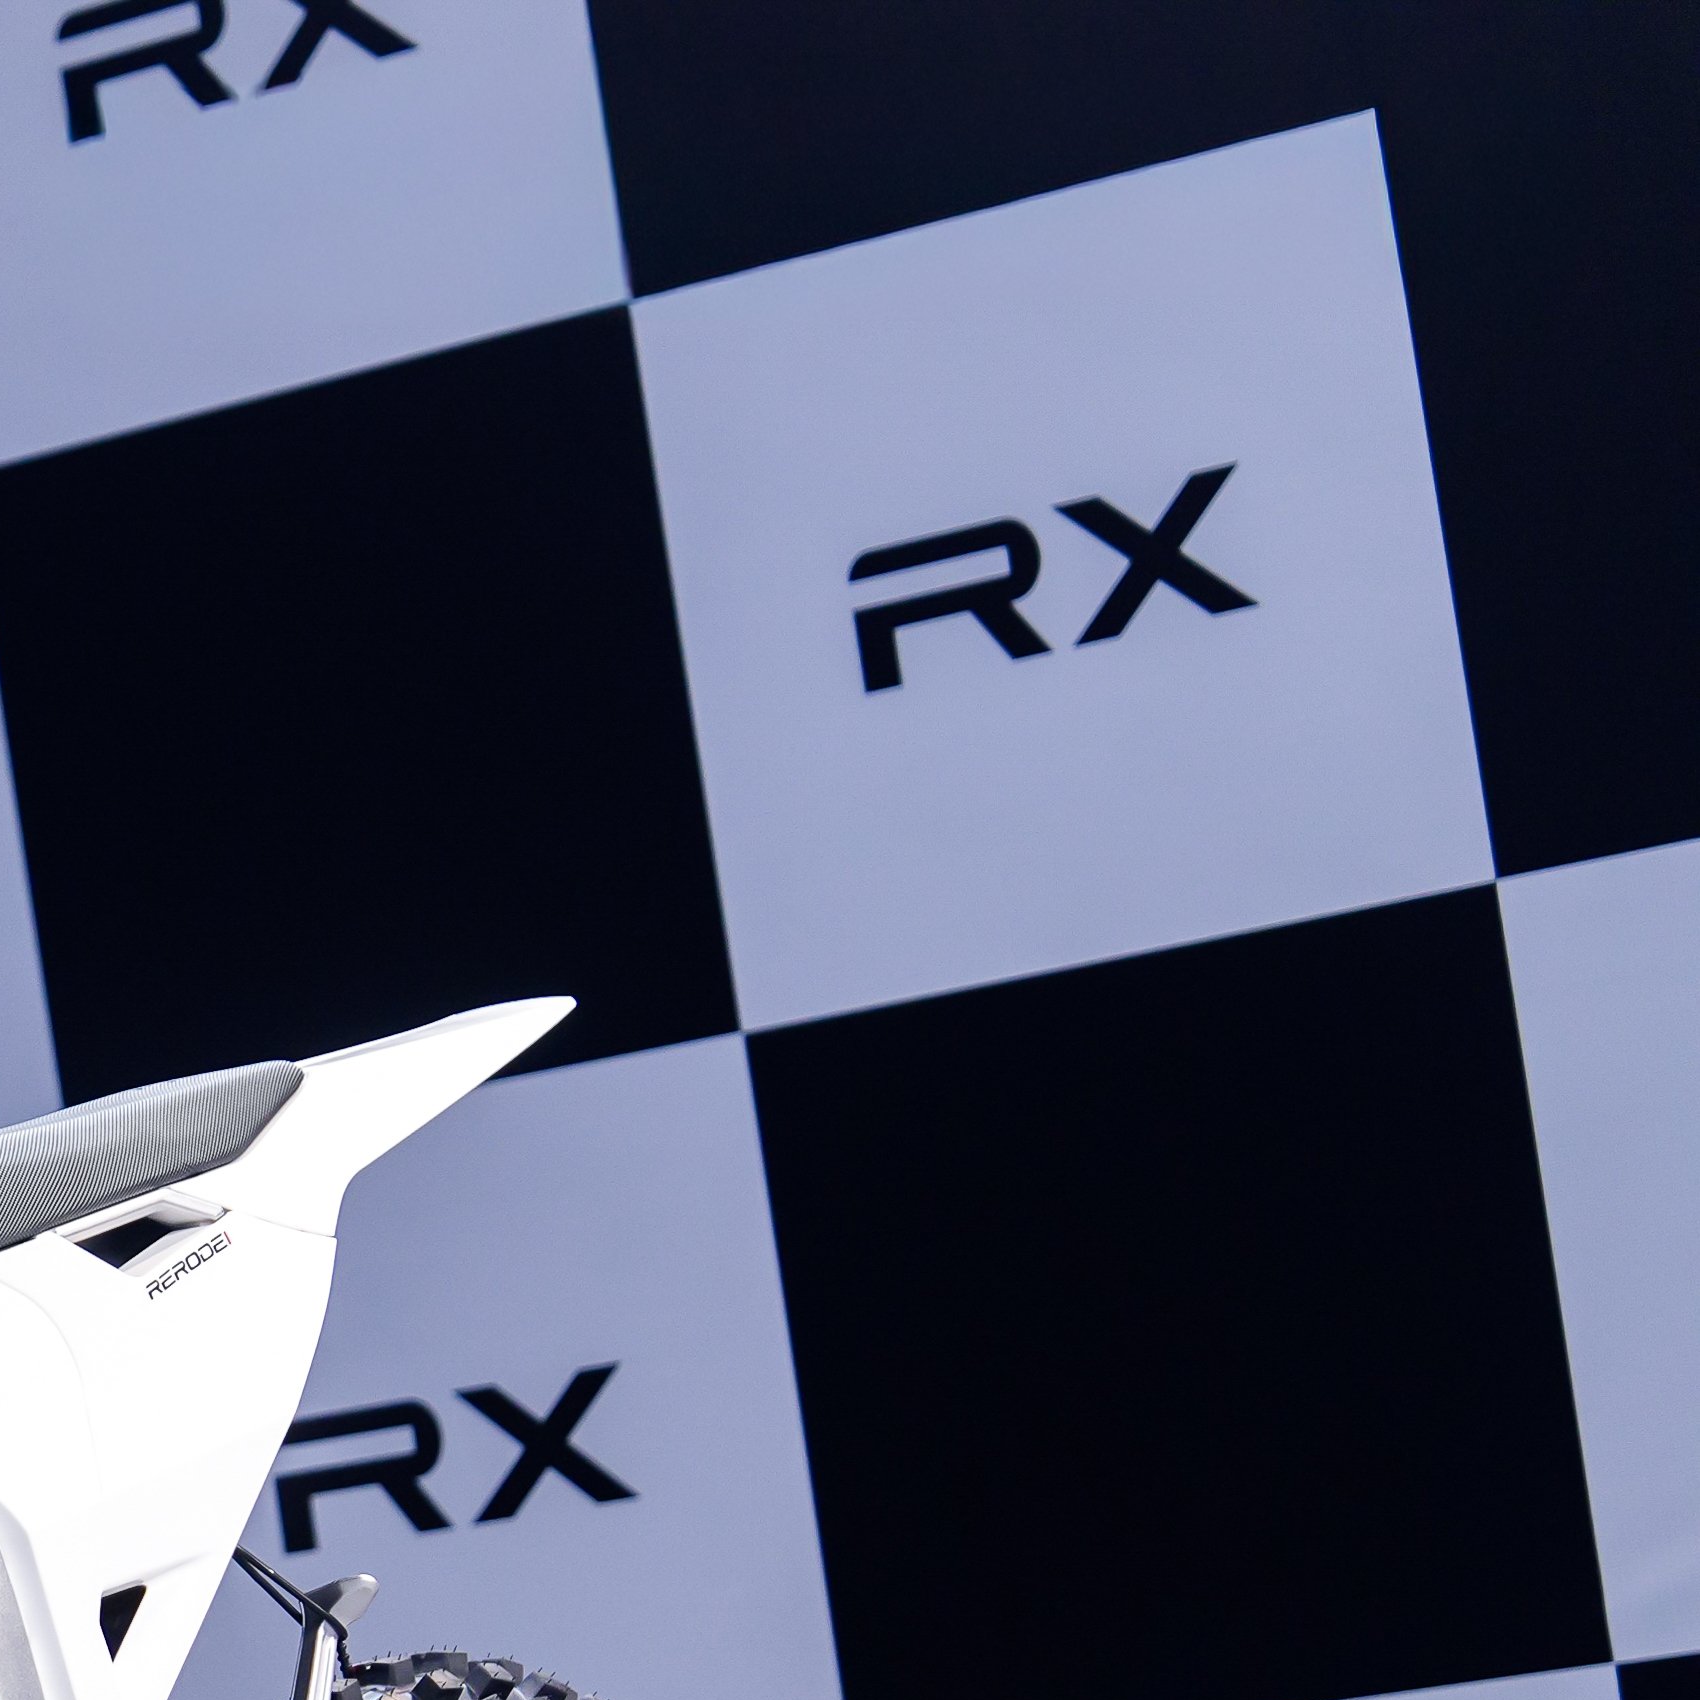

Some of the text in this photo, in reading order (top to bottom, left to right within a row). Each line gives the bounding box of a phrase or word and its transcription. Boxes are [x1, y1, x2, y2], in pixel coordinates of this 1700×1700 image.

[56, 0, 418, 144] RX
[847, 464, 1258, 693] RX
[274, 1361, 638, 1555] RX
